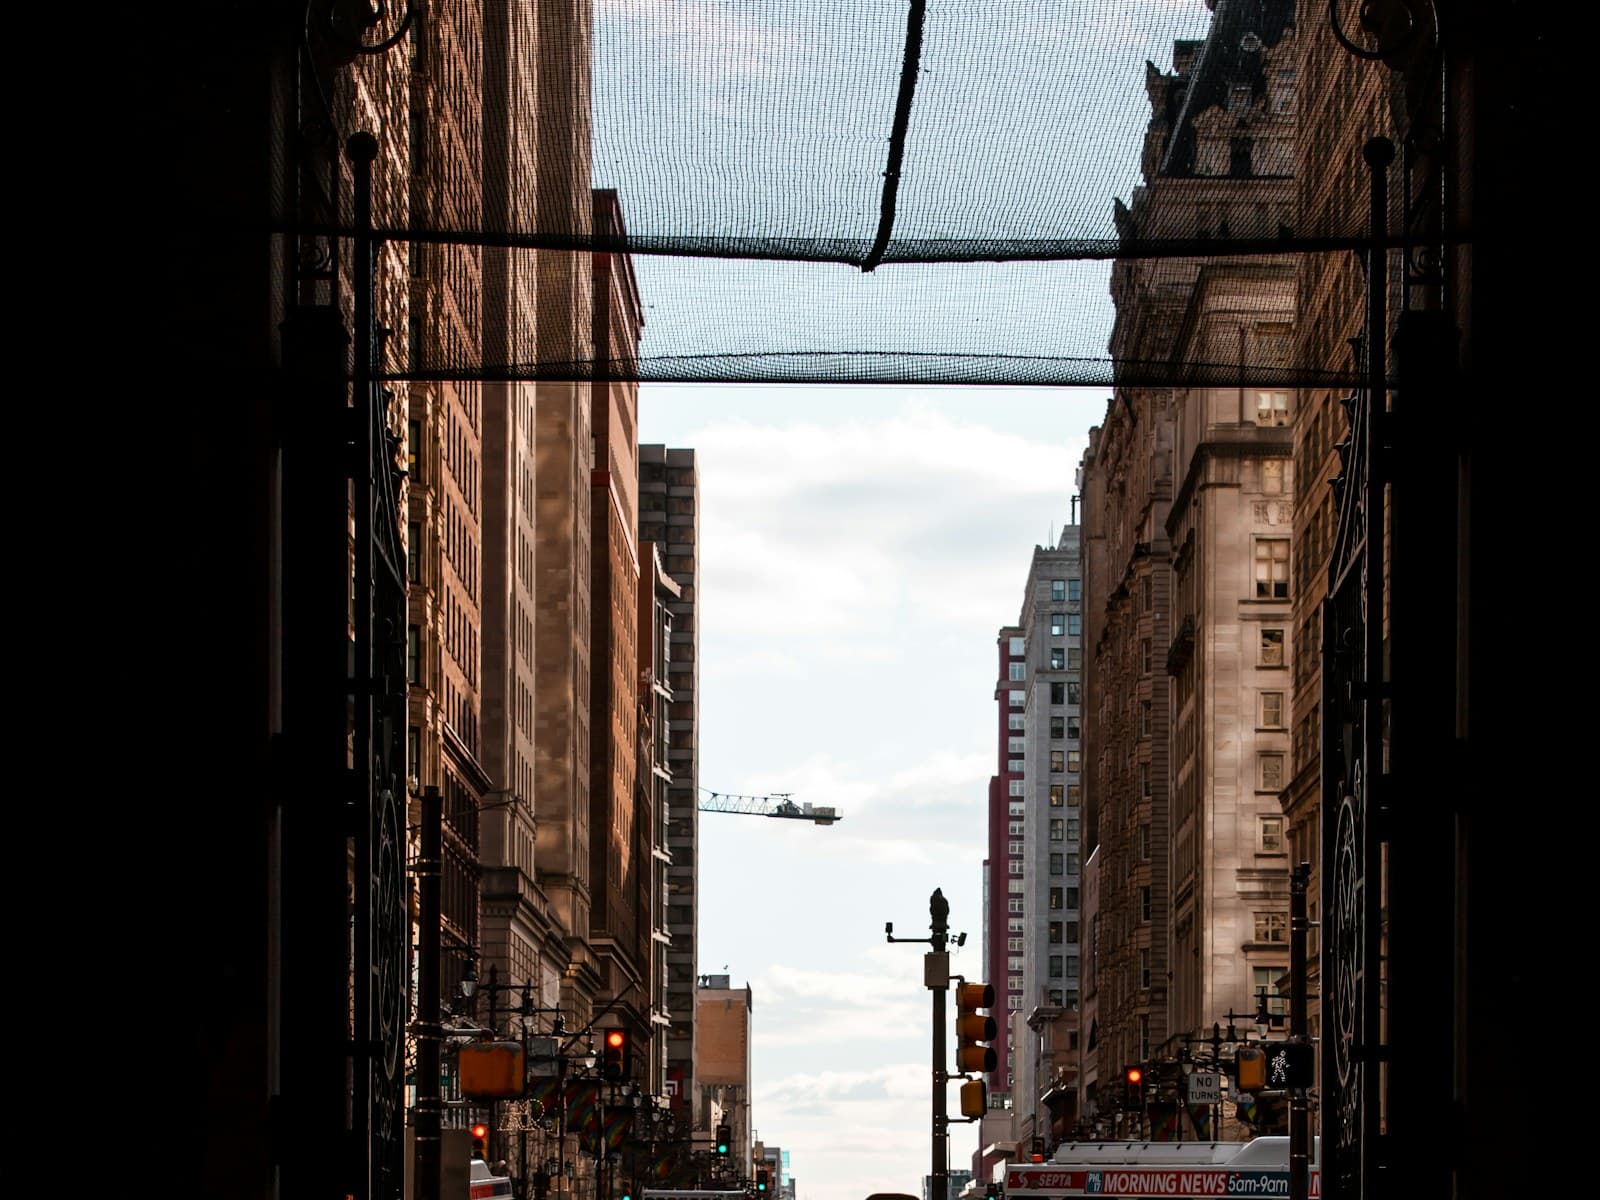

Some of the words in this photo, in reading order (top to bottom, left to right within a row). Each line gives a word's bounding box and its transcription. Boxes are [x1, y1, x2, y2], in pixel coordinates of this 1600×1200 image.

[1196, 1077, 1212, 1088] NO
[1191, 1091, 1219, 1100] TURNS
[1040, 1173, 1072, 1187] SEPTA
[1088, 1173, 1101, 1183] PHL
[1103, 1173, 1177, 1193] MORNING
[1180, 1173, 1226, 1193] NEWS
[1227, 1175, 1288, 1192] 5am-9am
[1093, 1182, 1102, 1192] 17
